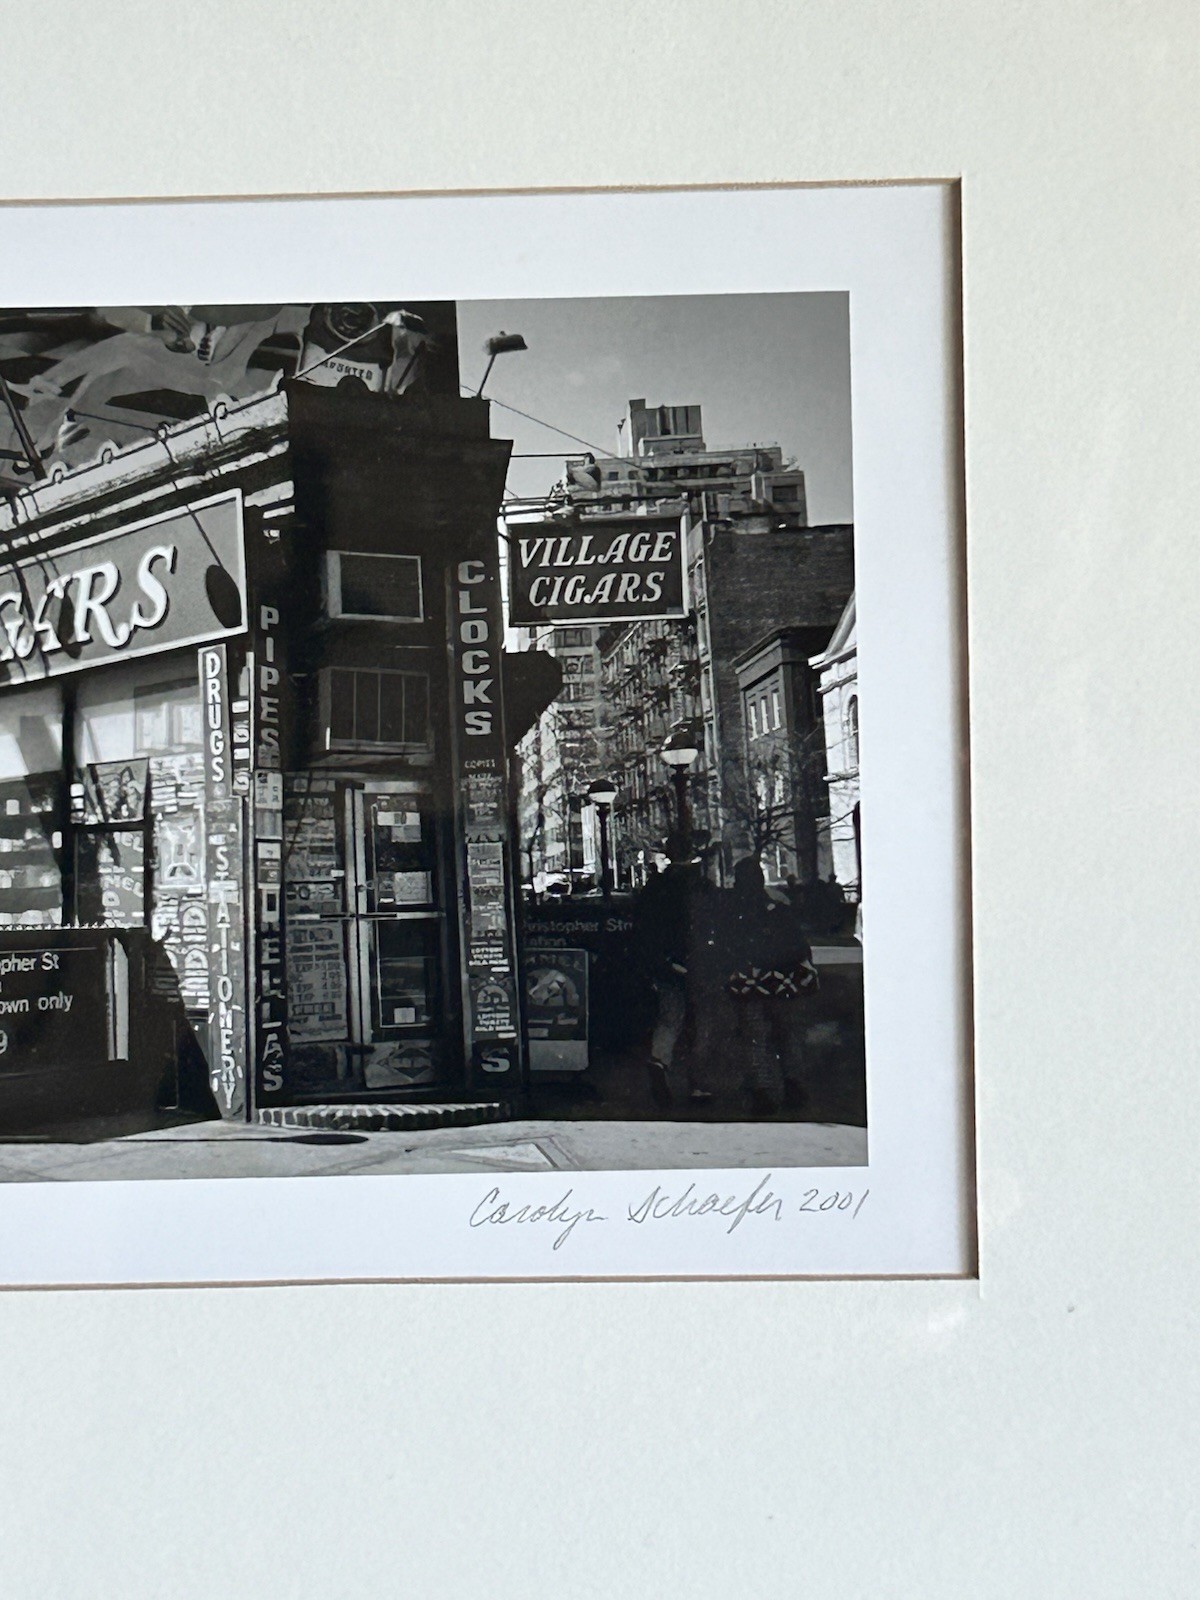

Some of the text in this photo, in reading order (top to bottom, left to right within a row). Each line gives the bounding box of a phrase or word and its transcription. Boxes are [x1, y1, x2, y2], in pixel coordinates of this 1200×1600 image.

[518, 530, 677, 568] VILLAGE
[528, 571, 666, 607] CIGARS
[457, 560, 494, 737] CLOCKS
[259, 605, 281, 754] PIPES
[204, 652, 227, 782] DRUGS
[0, 951, 60, 976] pher St
[37, 990, 74, 1013] only
[468, 1186, 609, 1251] Carolyn
[798, 1187, 871, 1222] 2001
